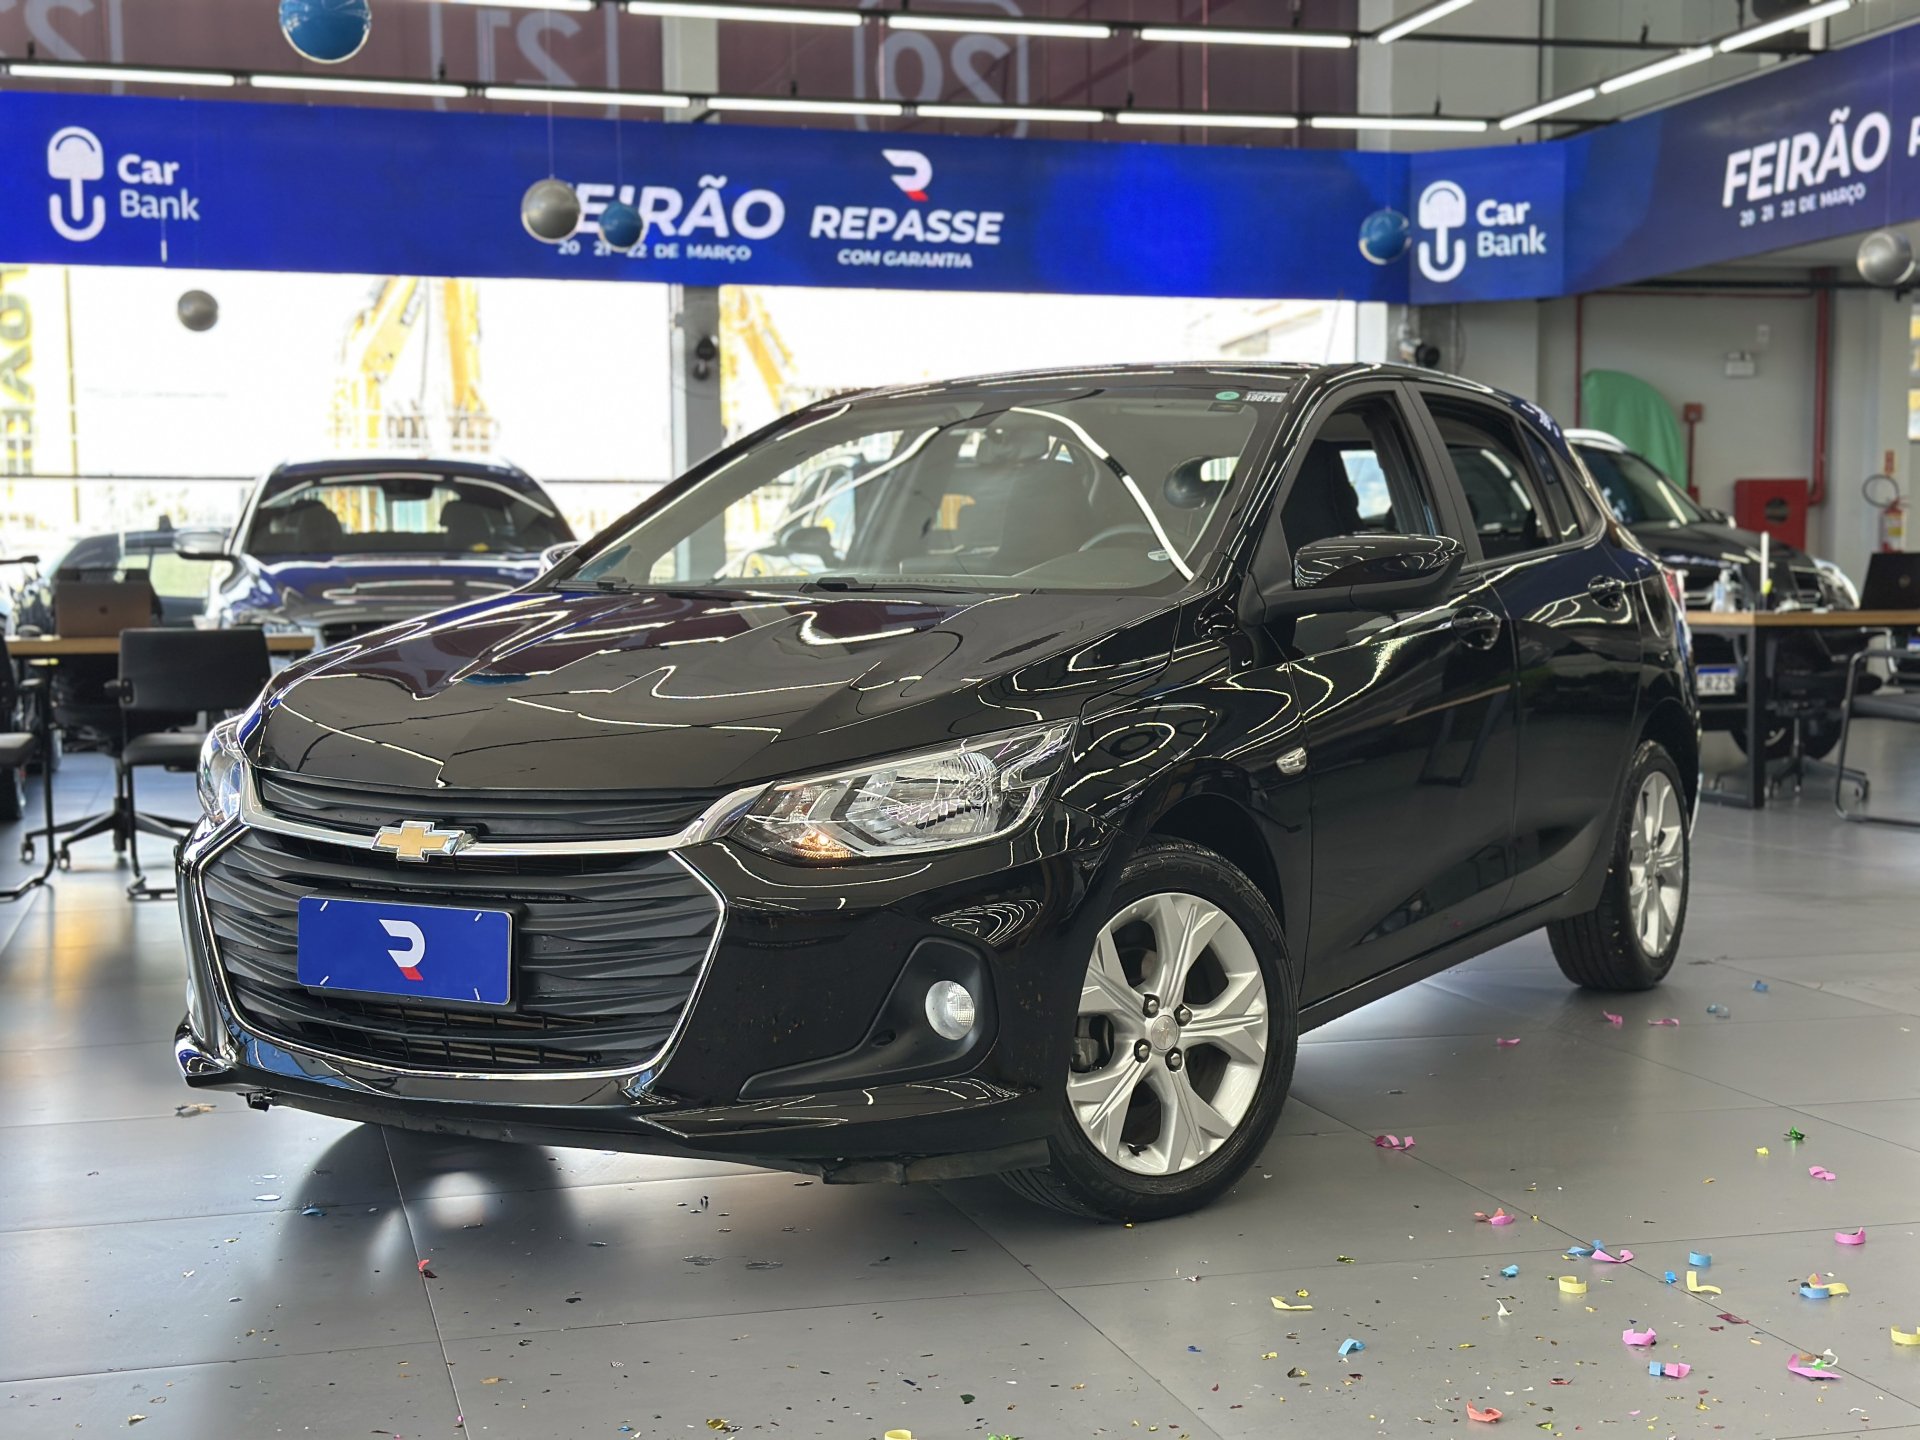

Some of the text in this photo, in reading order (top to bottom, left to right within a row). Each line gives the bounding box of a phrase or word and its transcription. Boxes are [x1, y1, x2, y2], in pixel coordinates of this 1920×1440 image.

[117, 153, 180, 186] Car
[1722, 106, 1891, 208] FEIRÃO
[119, 187, 201, 222] Bank
[1476, 198, 1531, 227] Car
[1739, 209, 1756, 228] 20
[1781, 199, 1796, 218] 22
[1799, 194, 1817, 214] DE
[1820, 182, 1867, 208] MARÇO
[809, 205, 1004, 245] REPASSE
[1477, 224, 1548, 258] Bank
[558, 240, 581, 255] 20
[654, 243, 680, 259] DE
[686, 244, 752, 264] MARÇO
[837, 248, 973, 269] COM GARANTIA
